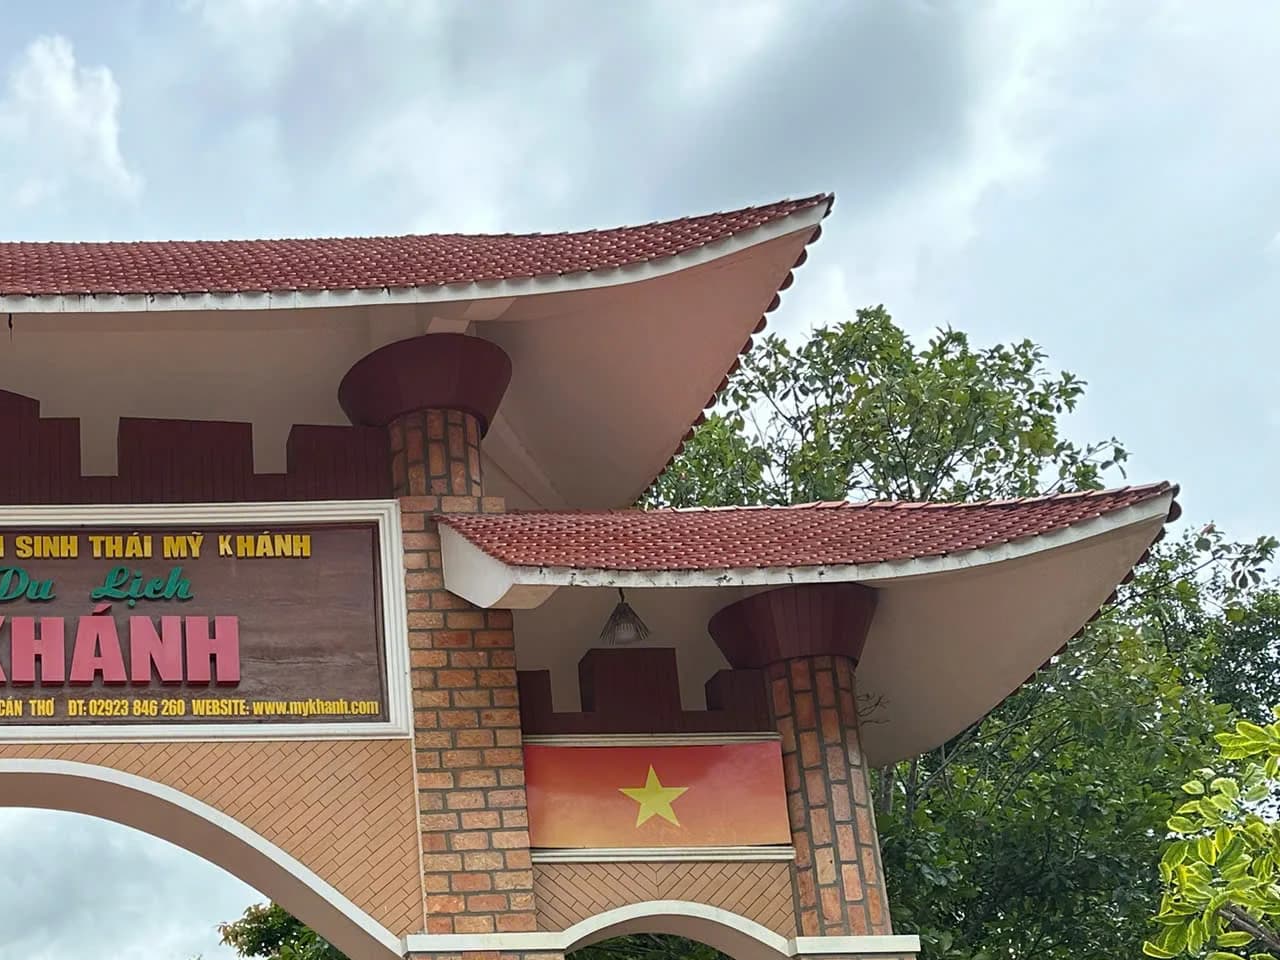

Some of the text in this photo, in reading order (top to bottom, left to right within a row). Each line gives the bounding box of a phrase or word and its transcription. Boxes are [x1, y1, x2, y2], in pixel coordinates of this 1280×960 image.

[15, 535, 78, 559] SINH
[89, 531, 153, 558] THÁI
[163, 531, 204, 558] MỸ
[218, 531, 311, 558] KHÁNH
[90, 565, 194, 608] Lịch
[29, 697, 55, 717] THƠ
[133, 698, 158, 717] 846
[161, 698, 186, 716] 260
[192, 698, 249, 716] WEBSITE:
[253, 697, 380, 718] www.mykhanh.com
